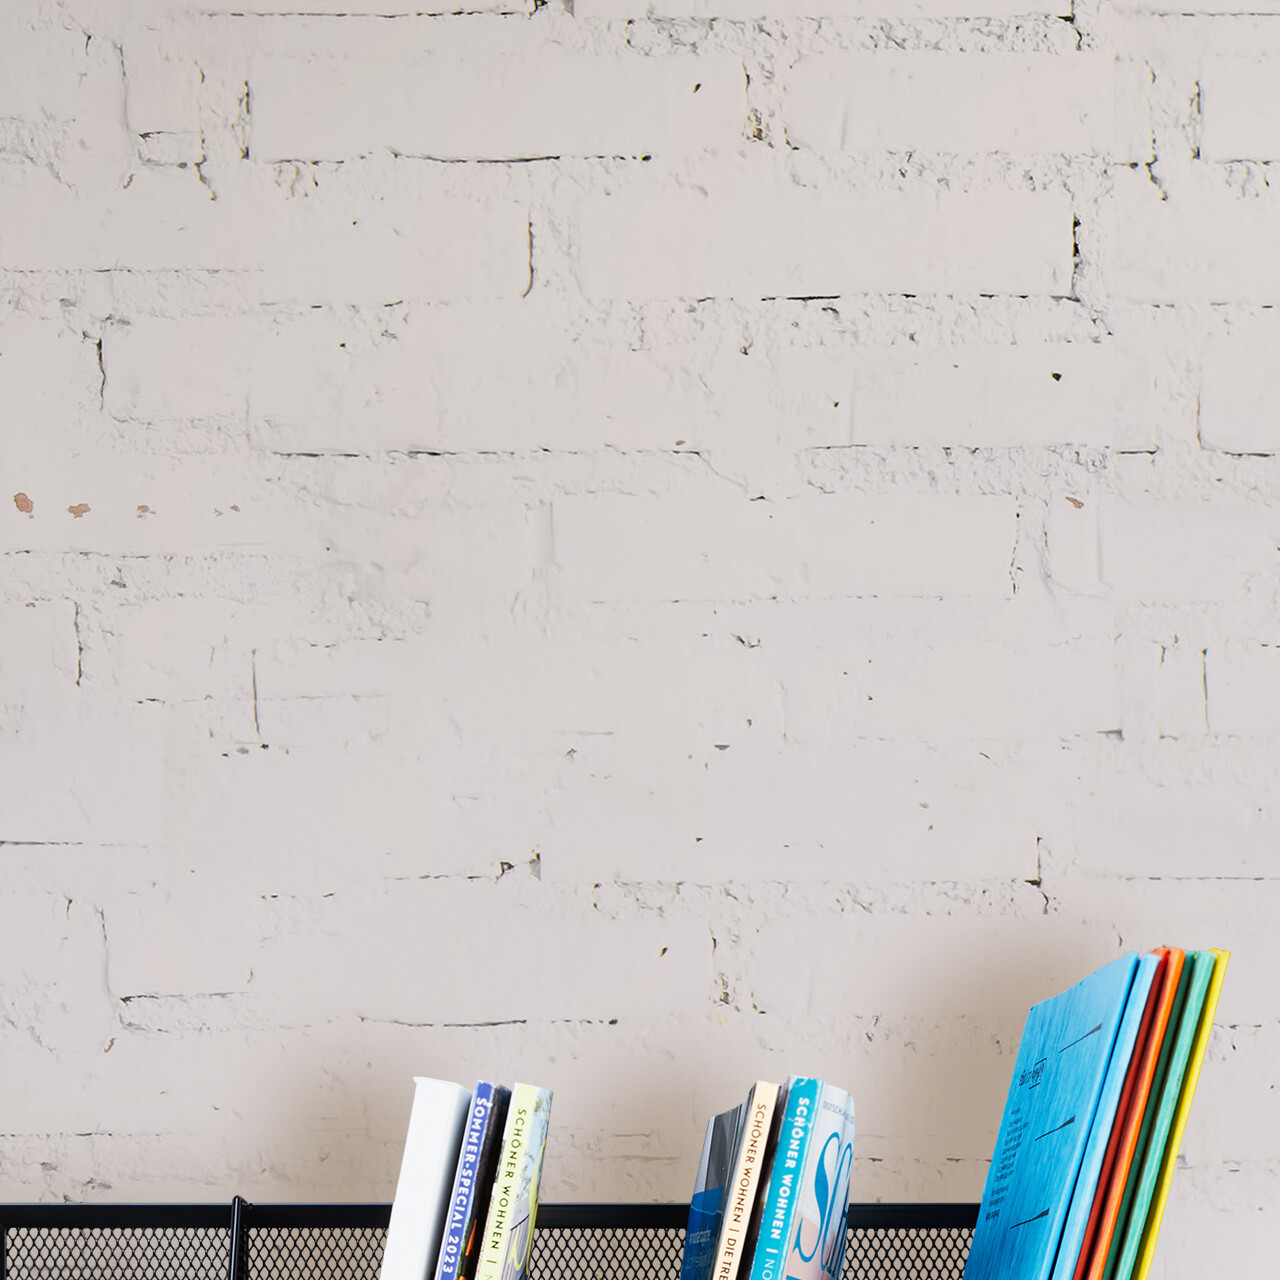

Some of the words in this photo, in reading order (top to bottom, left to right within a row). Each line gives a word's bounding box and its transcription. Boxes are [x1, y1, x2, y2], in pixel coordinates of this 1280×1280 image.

[450, 1097, 488, 1230] SOMMER-SPECIAL
[505, 1109, 526, 1178] SCHÖNER
[746, 1104, 766, 1163] SCHÖNER
[784, 1097, 810, 1168] SCHÖNER
[491, 1186, 512, 1249] WOHNEN
[733, 1167, 752, 1224] WOHNEN
[771, 1174, 794, 1240] WOHNEN
[443, 1235, 459, 1273] 2023
[724, 1238, 737, 1258] DIE
